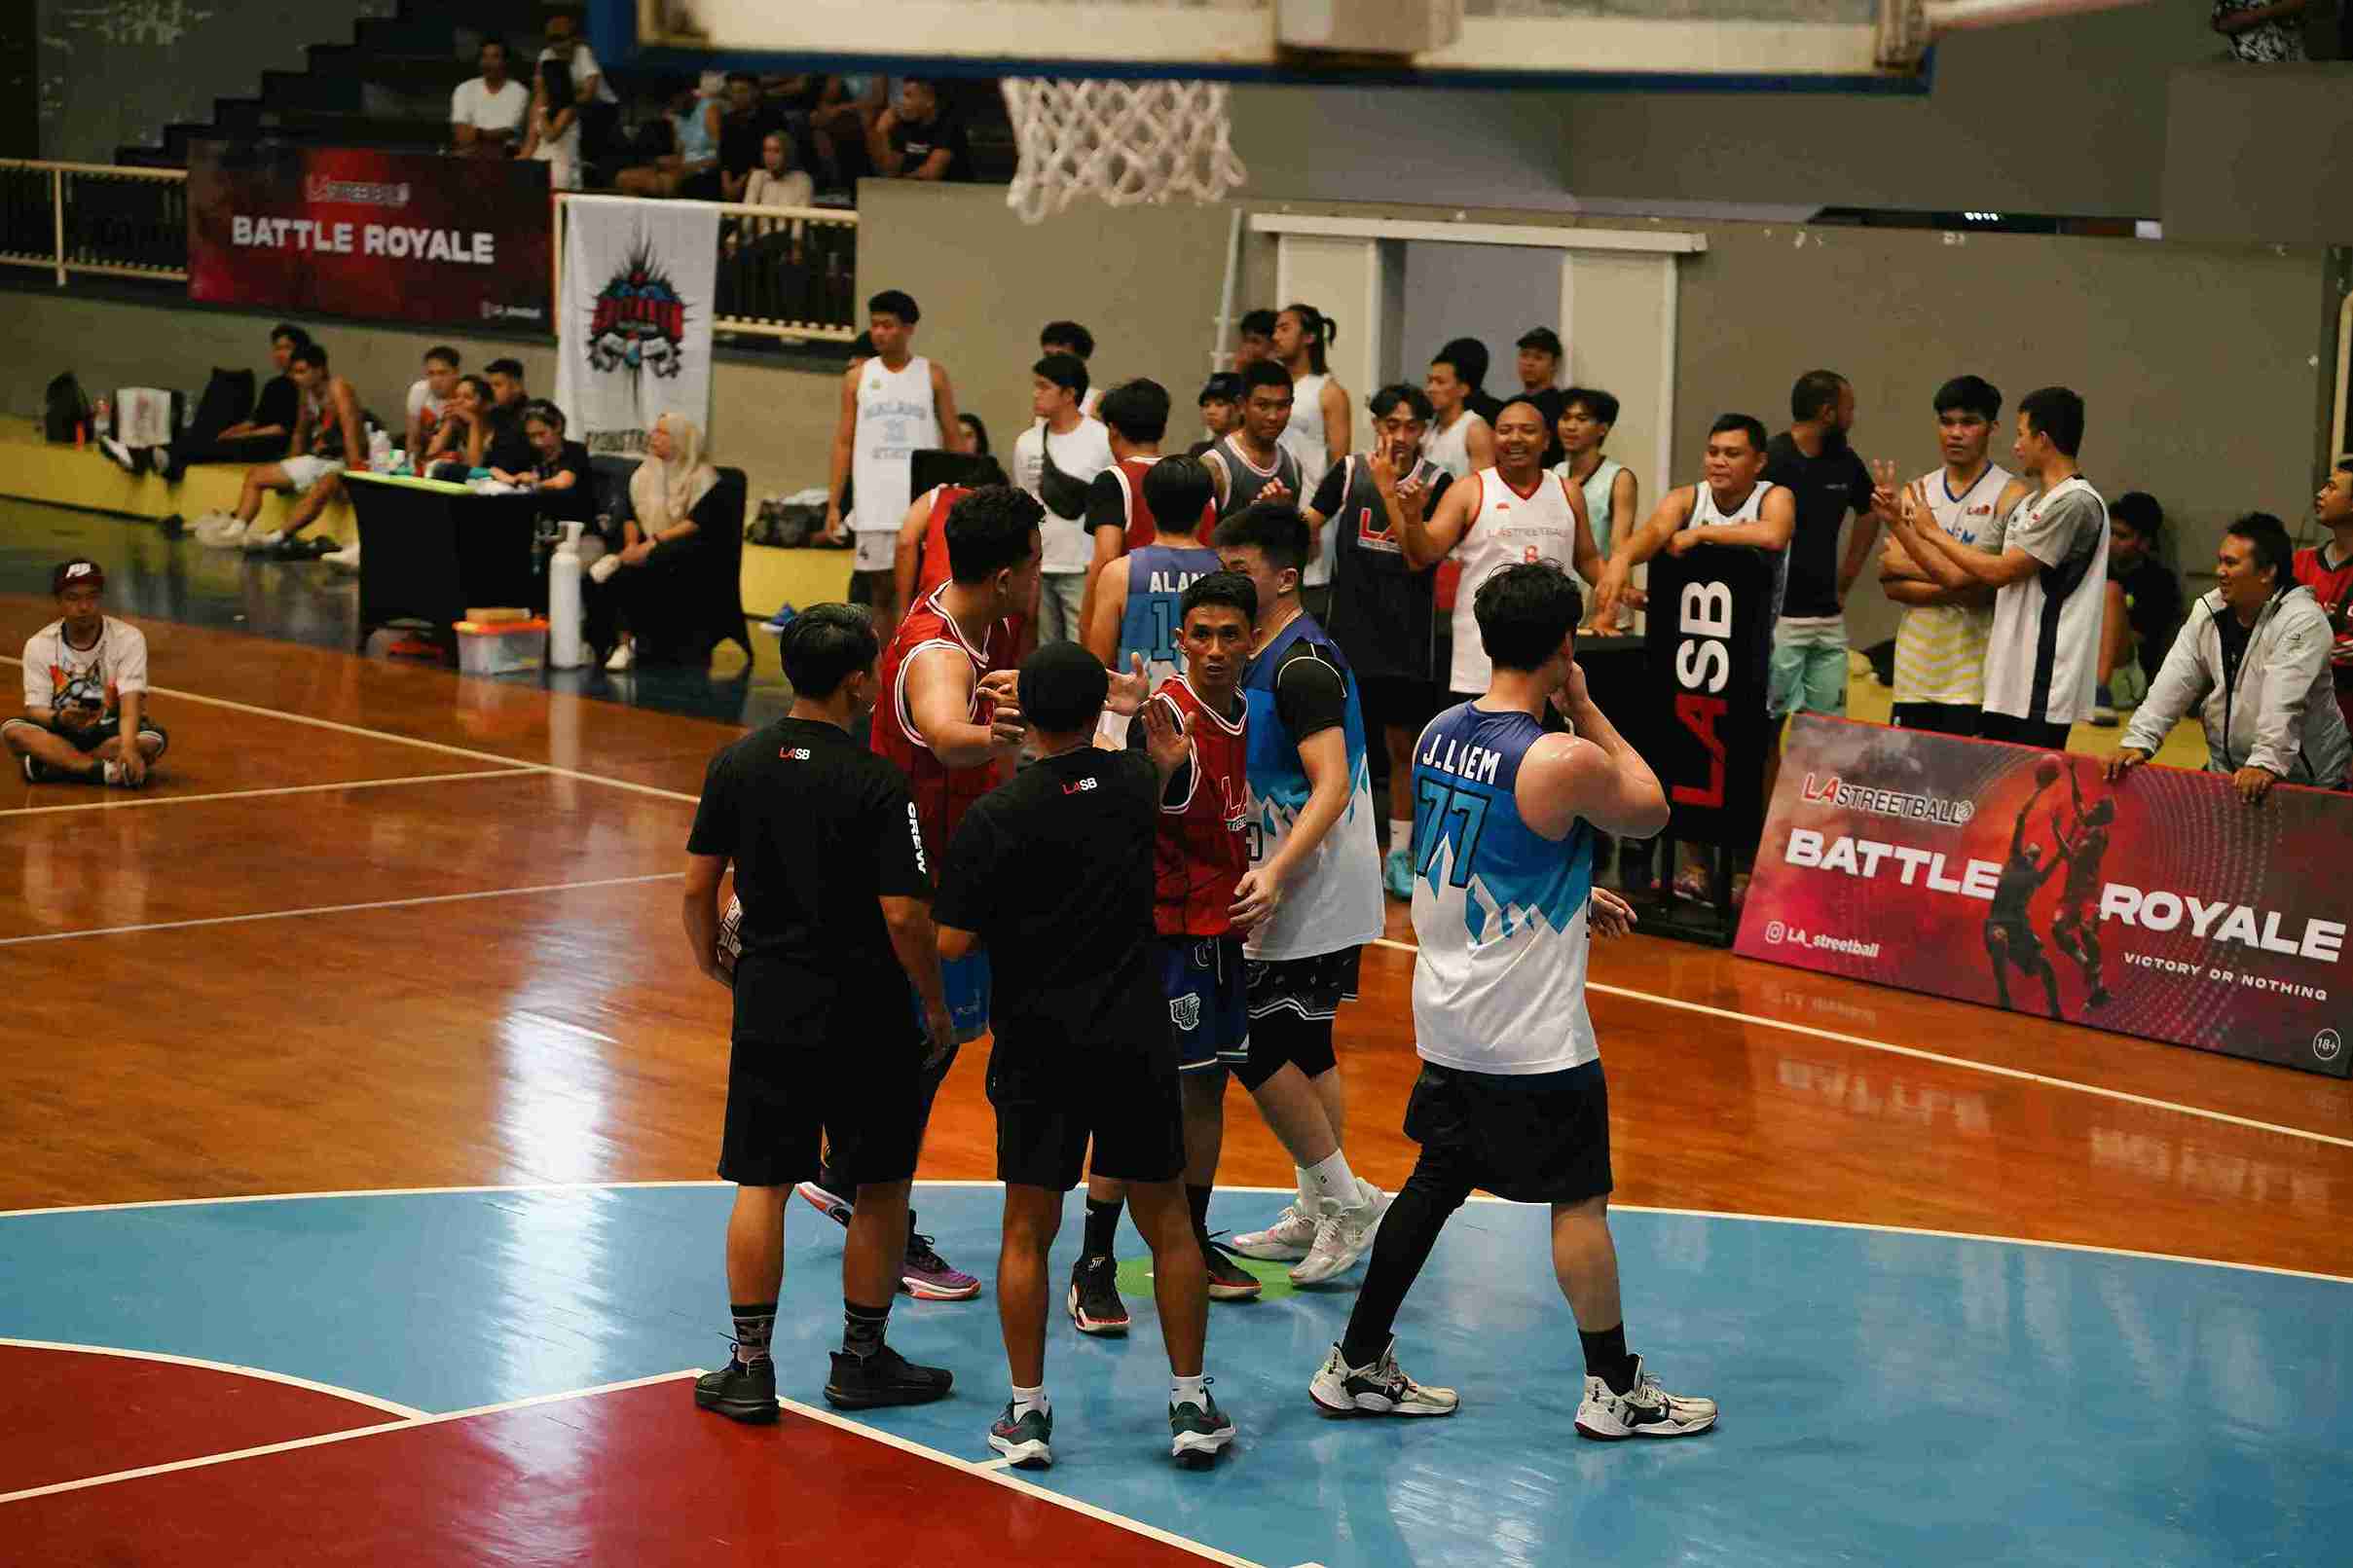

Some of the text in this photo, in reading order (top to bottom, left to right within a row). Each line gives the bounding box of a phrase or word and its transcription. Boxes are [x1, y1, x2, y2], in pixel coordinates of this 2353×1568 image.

[233, 216, 496, 264] BATTLE ROYALE
[1671, 580, 1733, 809] LASB
[779, 747, 811, 760] LASB
[1422, 733, 1502, 785] J.LIEM
[1061, 777, 1098, 795] LASB
[1801, 773, 1967, 827] LASTREETBALL
[907, 801, 927, 874] CREW
[1415, 775, 1492, 890] 77
[1784, 827, 2347, 964] BATTLE ROYALE
[1785, 925, 1881, 959] LA_streetball
[2123, 951, 2329, 1003] VICTORY OR NOTHING
[2316, 1037, 2337, 1052] 18+
